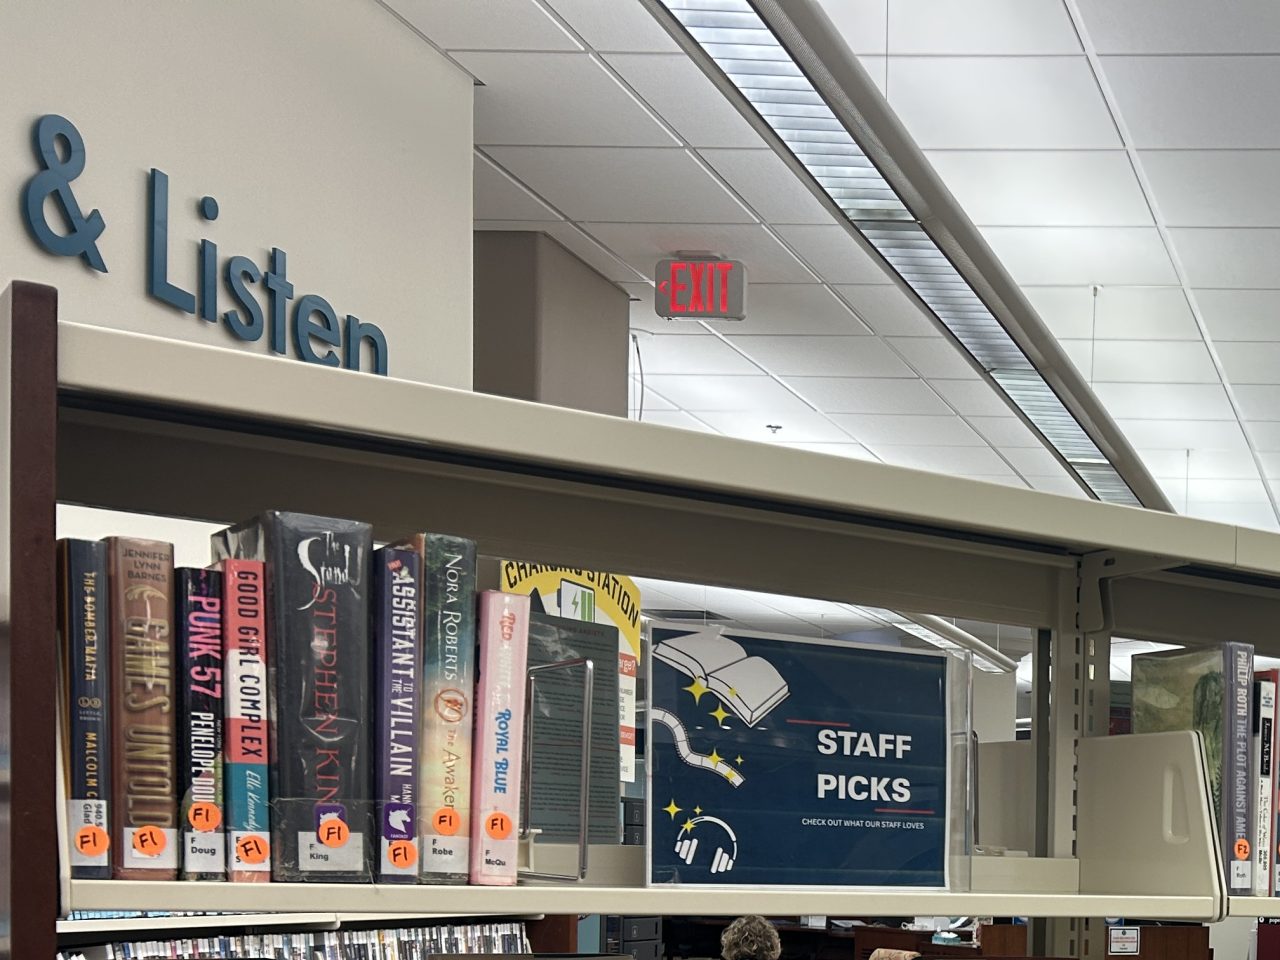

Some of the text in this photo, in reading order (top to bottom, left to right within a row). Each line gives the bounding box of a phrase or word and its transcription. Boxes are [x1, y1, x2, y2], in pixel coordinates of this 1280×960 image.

[22, 114, 389, 377] & Listen
[670, 263, 733, 312] EXIT
[188, 595, 221, 699] PUNK 57
[236, 571, 262, 758] GOOD GIRL COMPLEX
[313, 588, 337, 734] STEPHEN
[391, 571, 416, 678] ASSISTANT
[443, 554, 462, 681] NORA ROBERTS
[124, 616, 172, 826] GAMES UNTOLD
[390, 698, 413, 777] VILLAIN
[494, 709, 511, 795] ROYAL BLUE
[817, 729, 912, 758] STAFF
[1234, 650, 1248, 816] PHILIP ROTH THE PLOT AGAINST
[817, 774, 911, 802] PICKS
[191, 846, 216, 855] Doug
[309, 852, 328, 862] King
